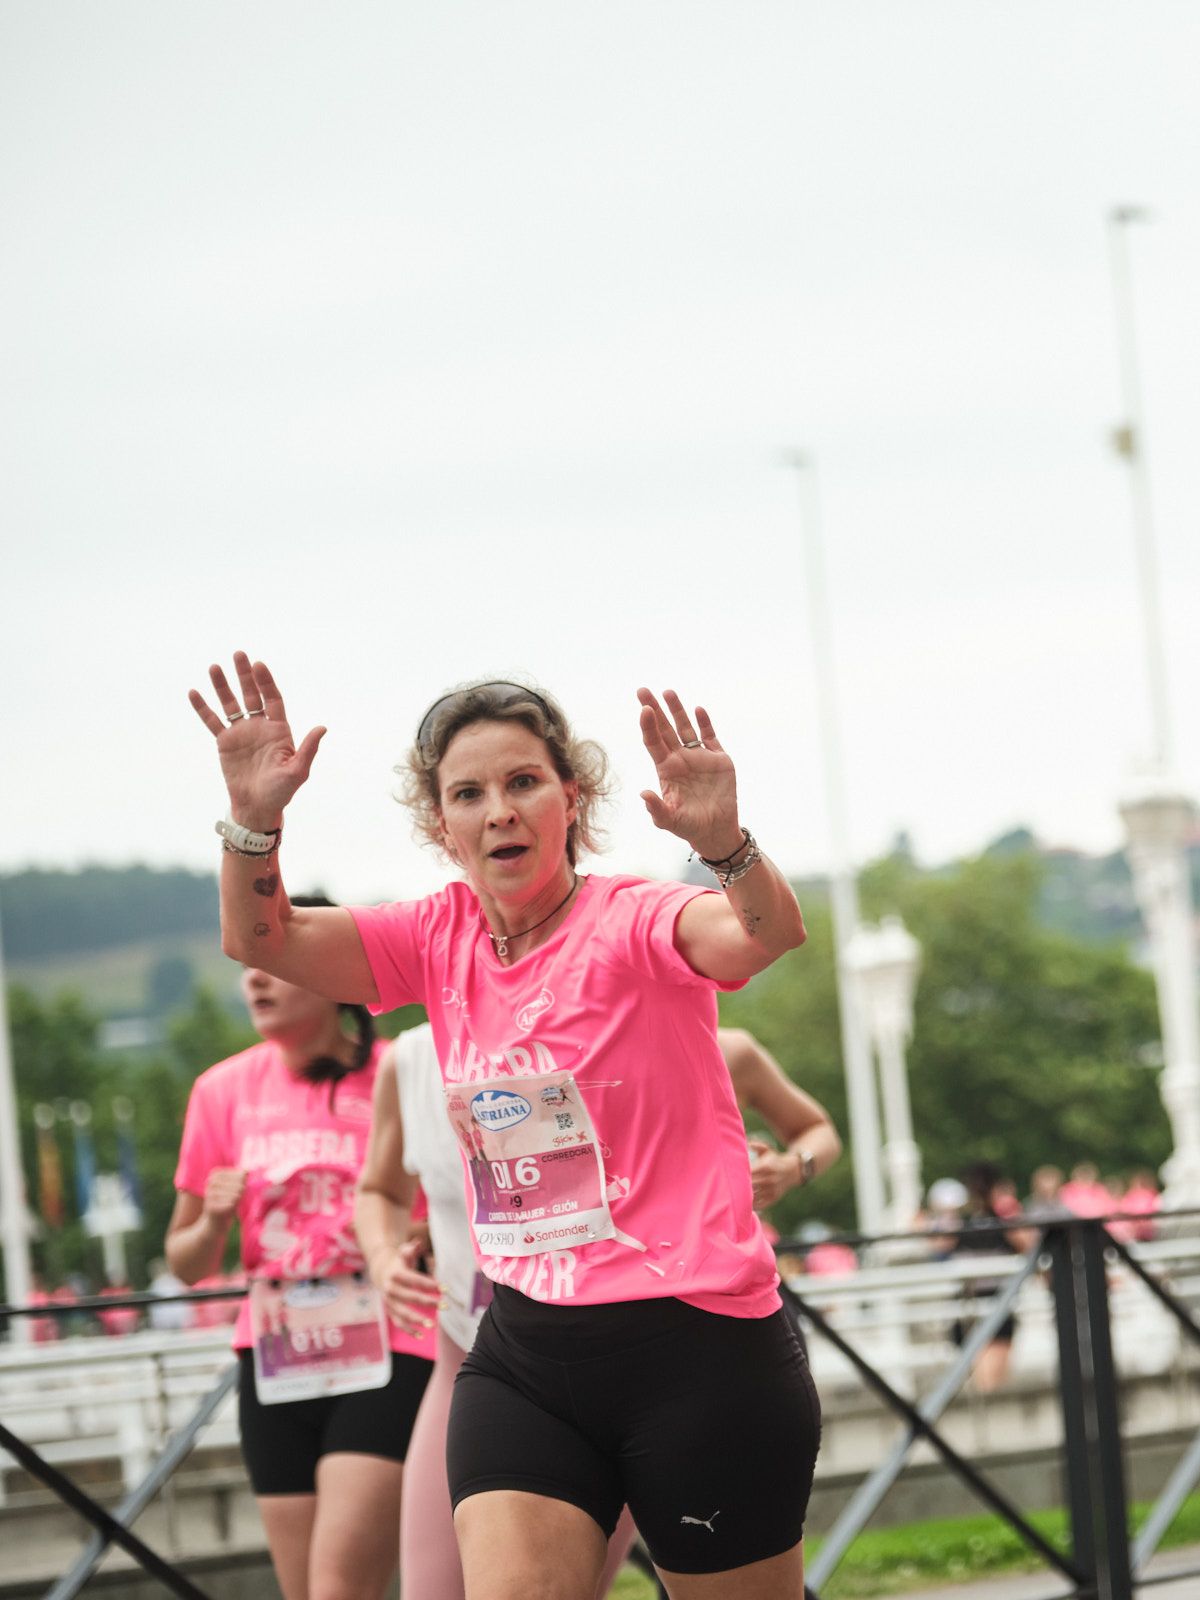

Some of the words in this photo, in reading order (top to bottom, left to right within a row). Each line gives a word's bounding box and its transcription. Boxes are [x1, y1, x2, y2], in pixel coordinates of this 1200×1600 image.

[491, 1156, 541, 1190] 016
[541, 1147, 593, 1163] CORREDORA
[535, 1224, 589, 1242] Santander
